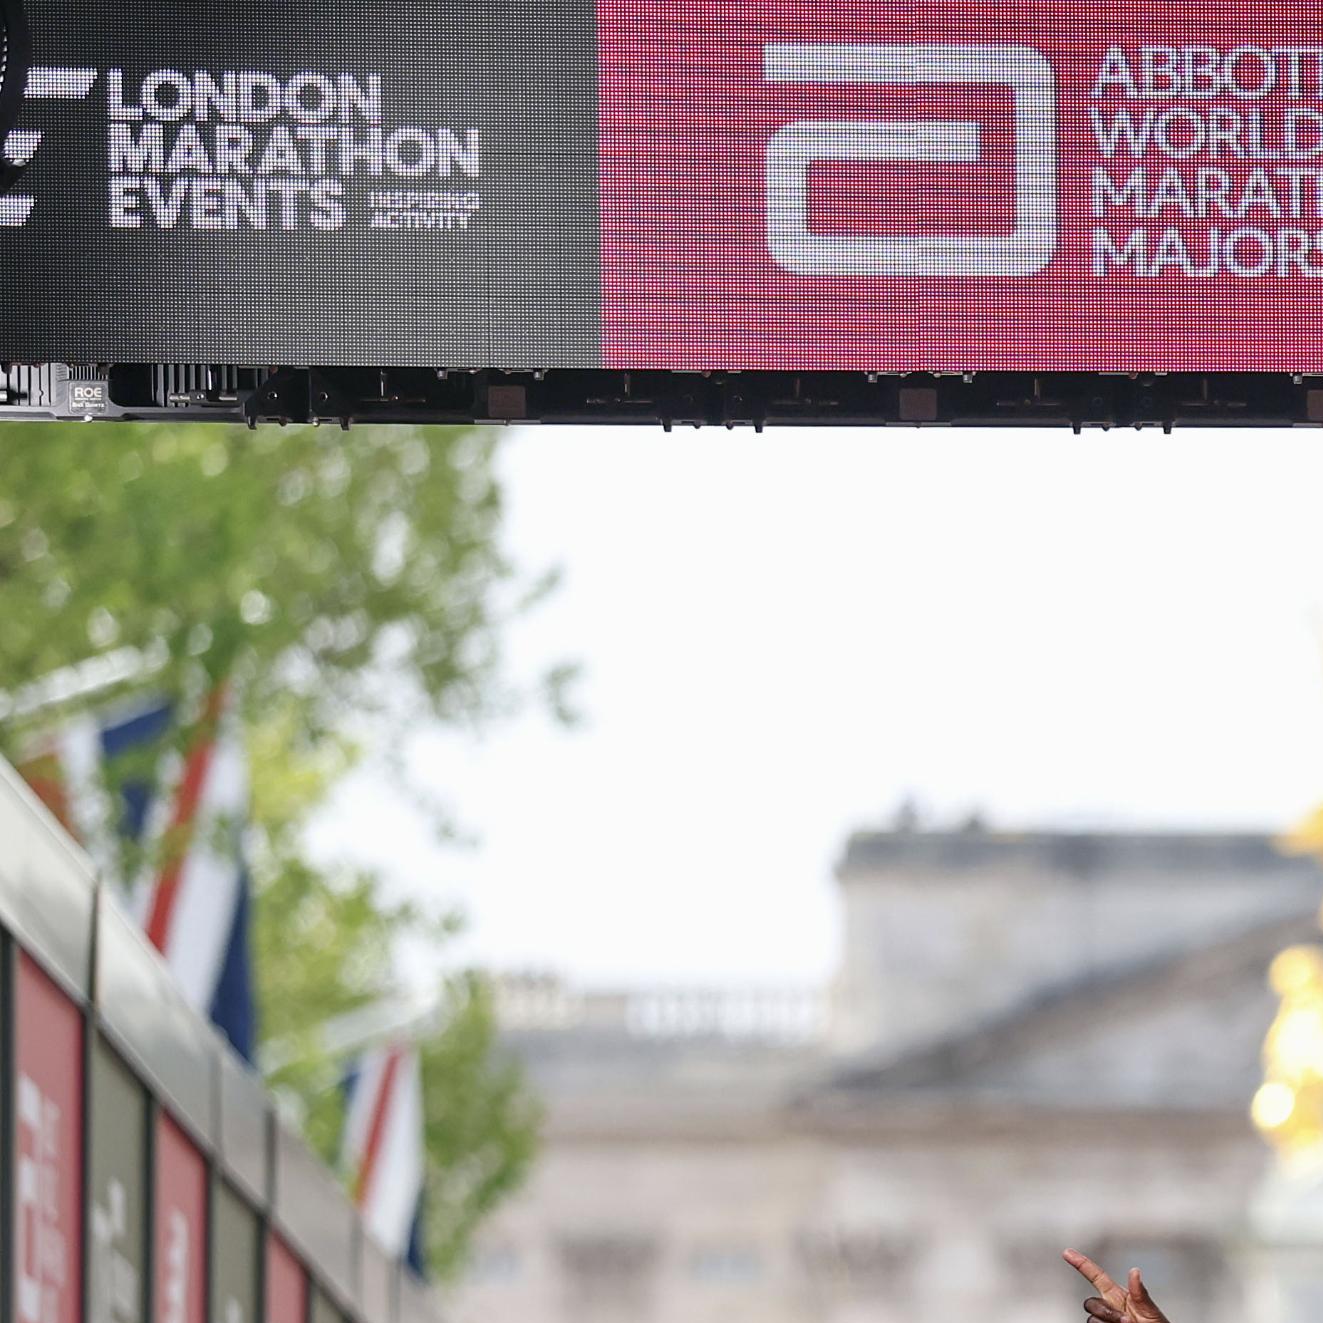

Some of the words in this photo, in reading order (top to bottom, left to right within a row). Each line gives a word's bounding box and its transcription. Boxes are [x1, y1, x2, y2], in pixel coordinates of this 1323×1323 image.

[107, 68, 382, 124] LONDON
[107, 122, 480, 178] MARATHON
[108, 176, 347, 231] EVENTS
[369, 211, 473, 230] ACTIVITY
[74, 387, 102, 398] ROE
